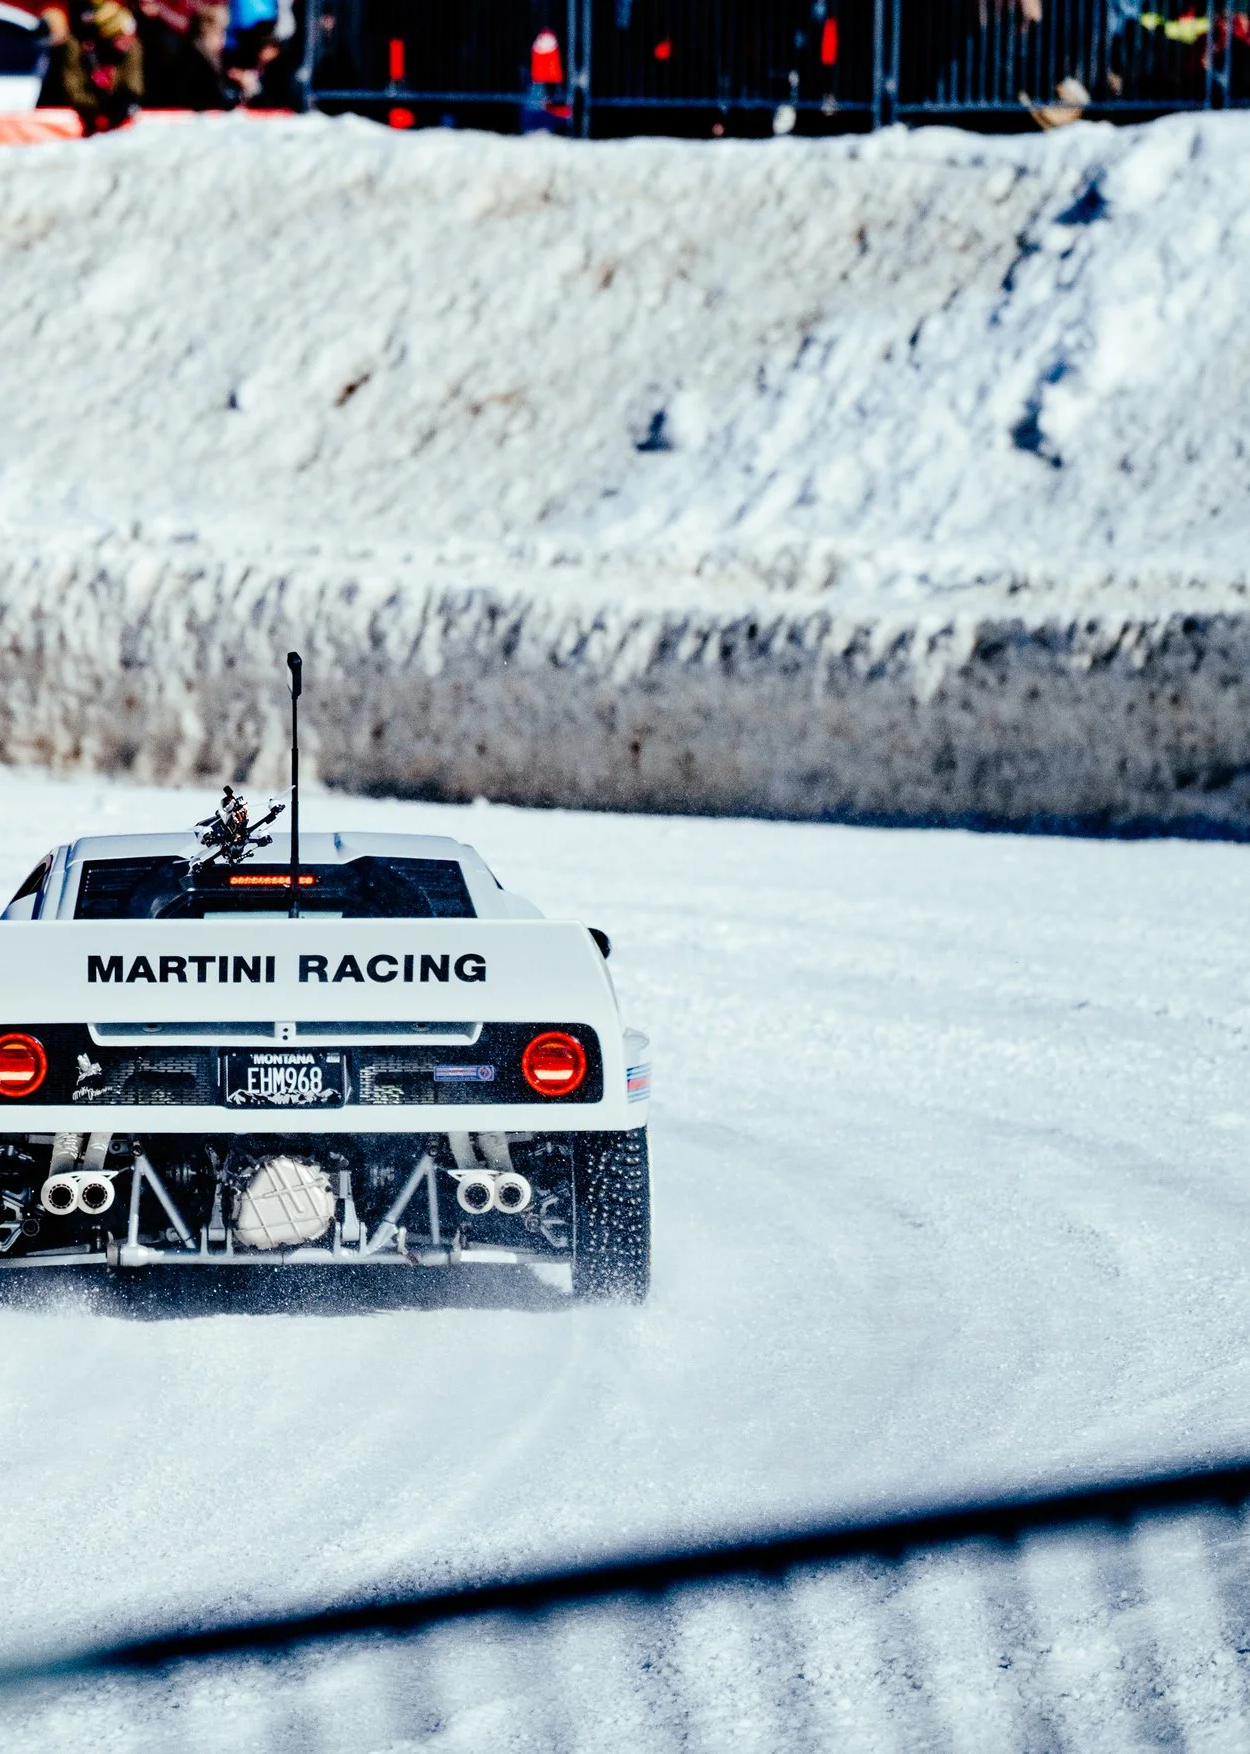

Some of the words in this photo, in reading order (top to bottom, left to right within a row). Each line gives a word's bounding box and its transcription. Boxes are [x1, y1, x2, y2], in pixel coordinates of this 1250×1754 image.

[87, 955, 276, 983] MARTINI
[298, 954, 487, 983] RACING
[253, 1053, 315, 1065] MONTANA
[247, 1067, 323, 1094] EHM968
